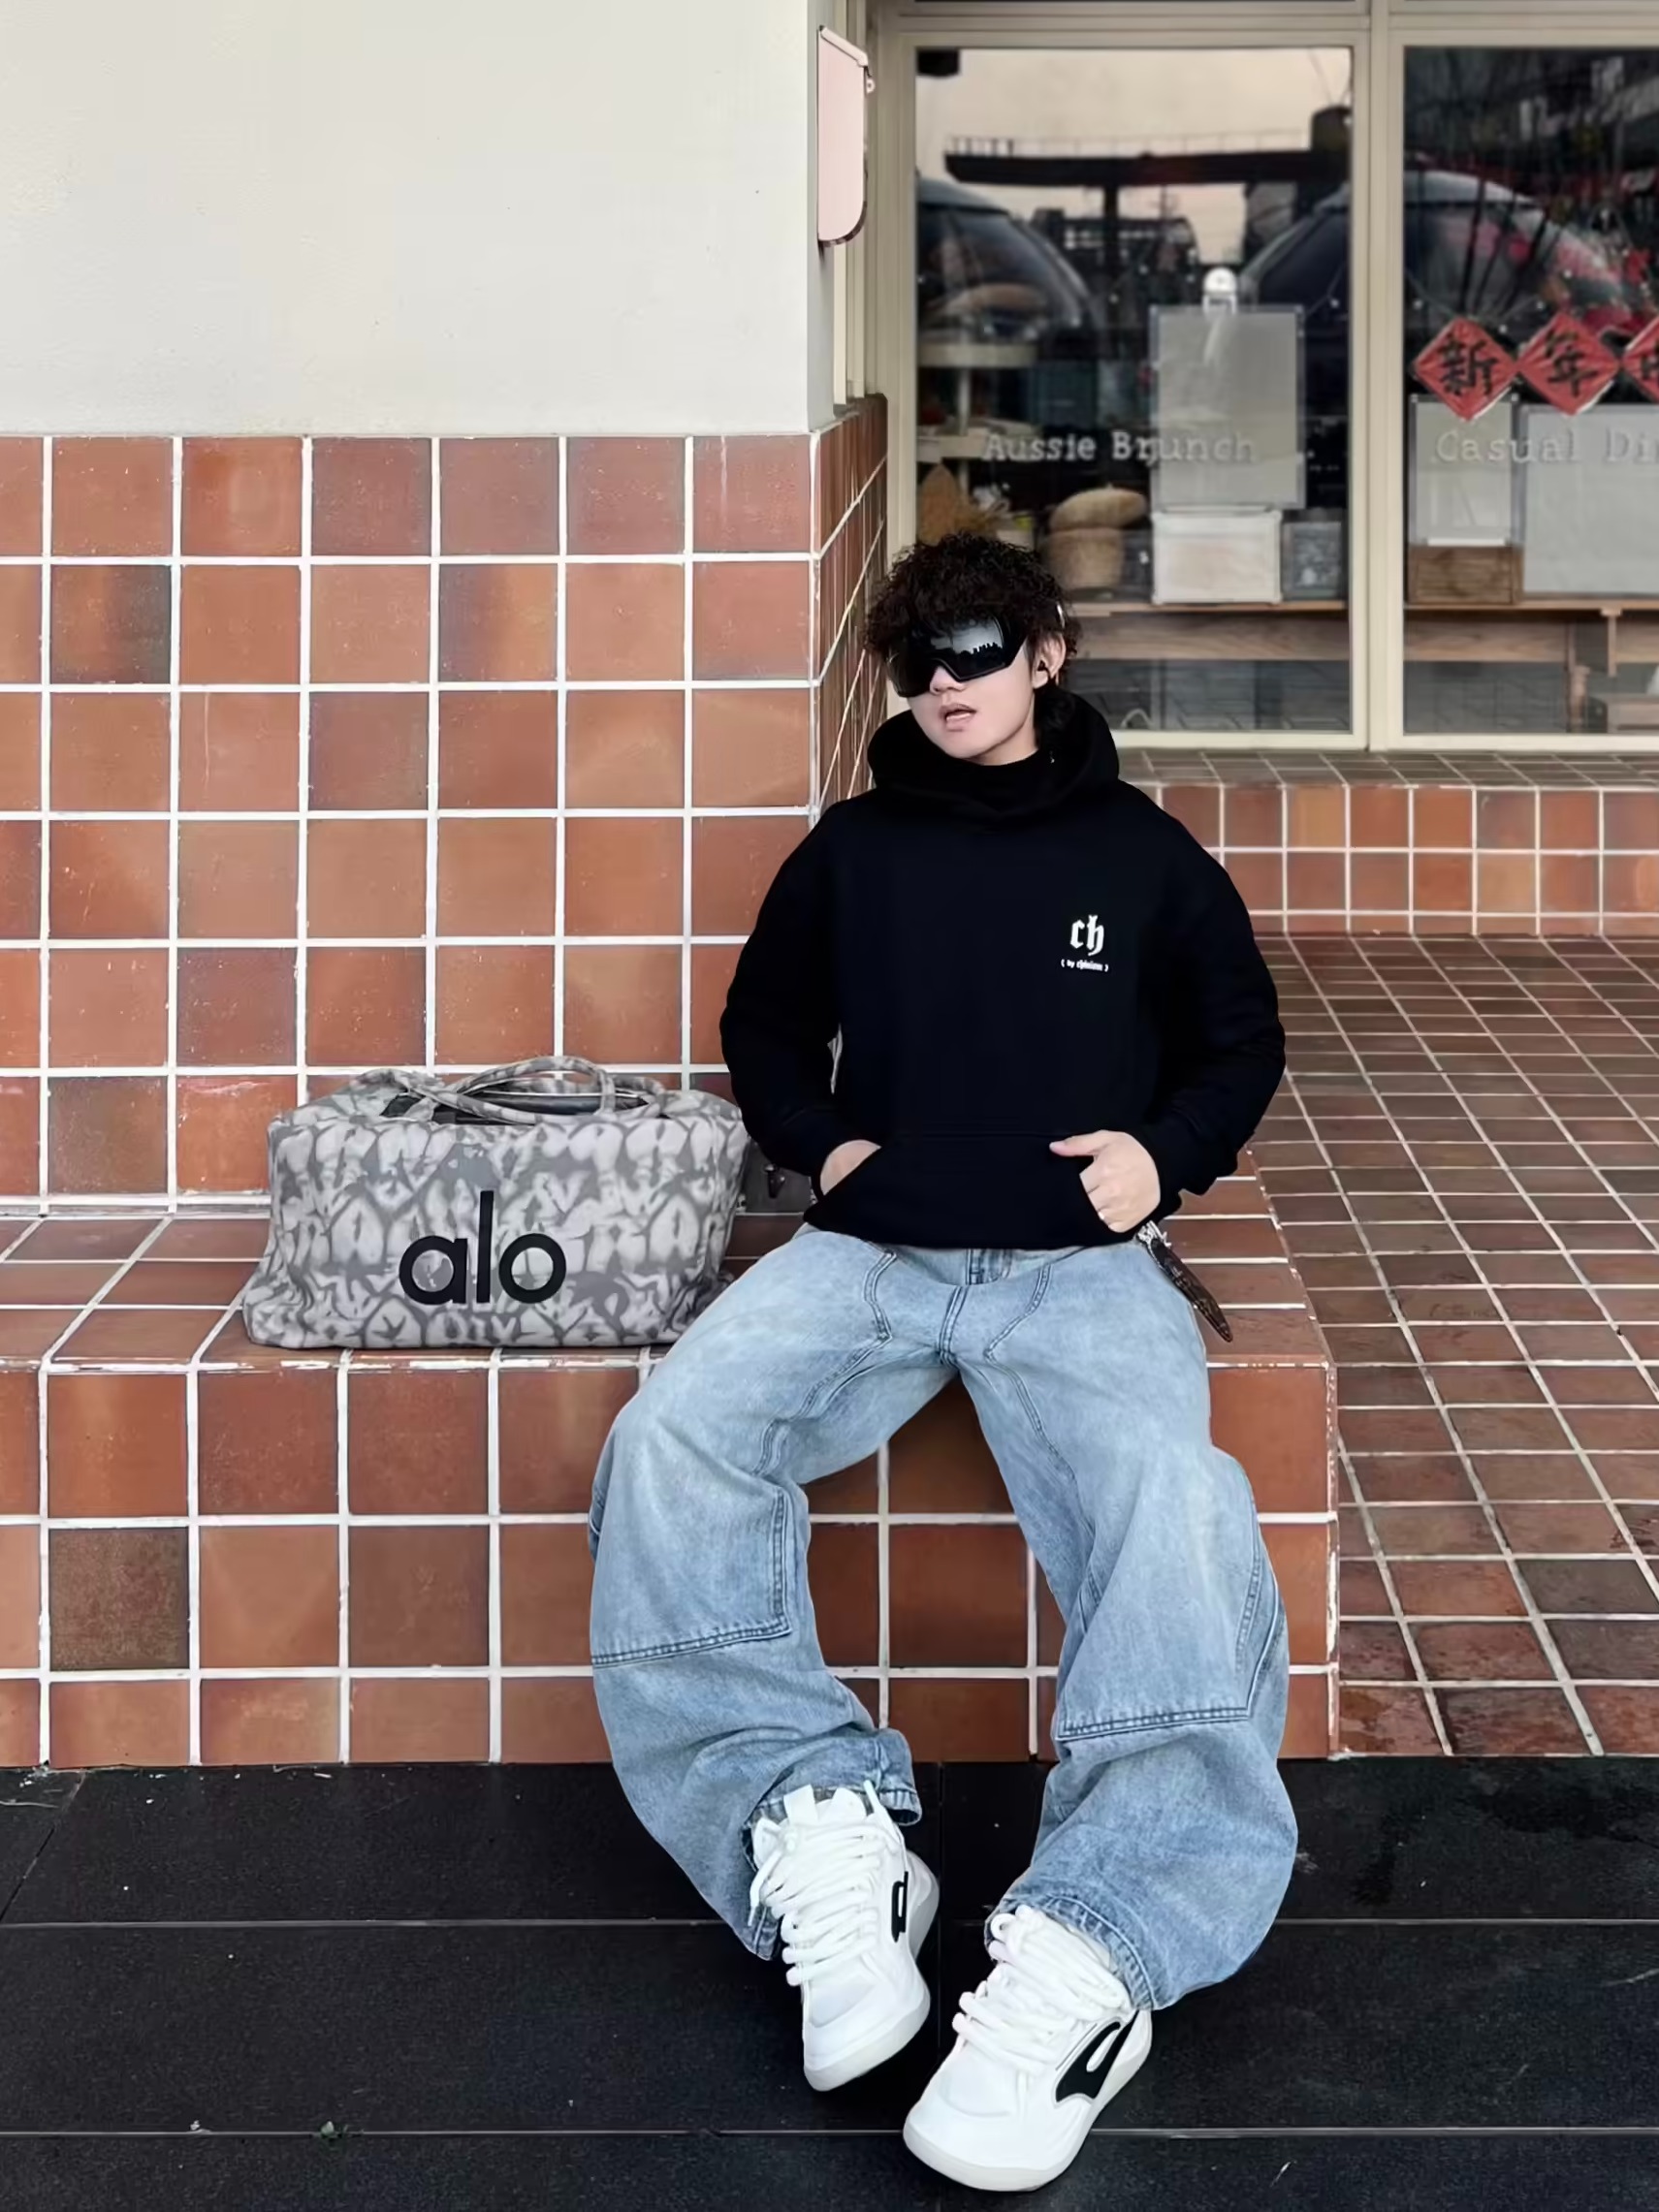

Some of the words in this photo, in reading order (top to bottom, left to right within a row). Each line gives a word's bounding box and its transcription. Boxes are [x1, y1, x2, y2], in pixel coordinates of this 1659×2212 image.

[982, 432, 1096, 461] Aussie
[1111, 429, 1257, 463] Brunch
[1433, 429, 1582, 463] Casual
[1606, 428, 1659, 463] Di
[399, 1190, 567, 1305] alo
